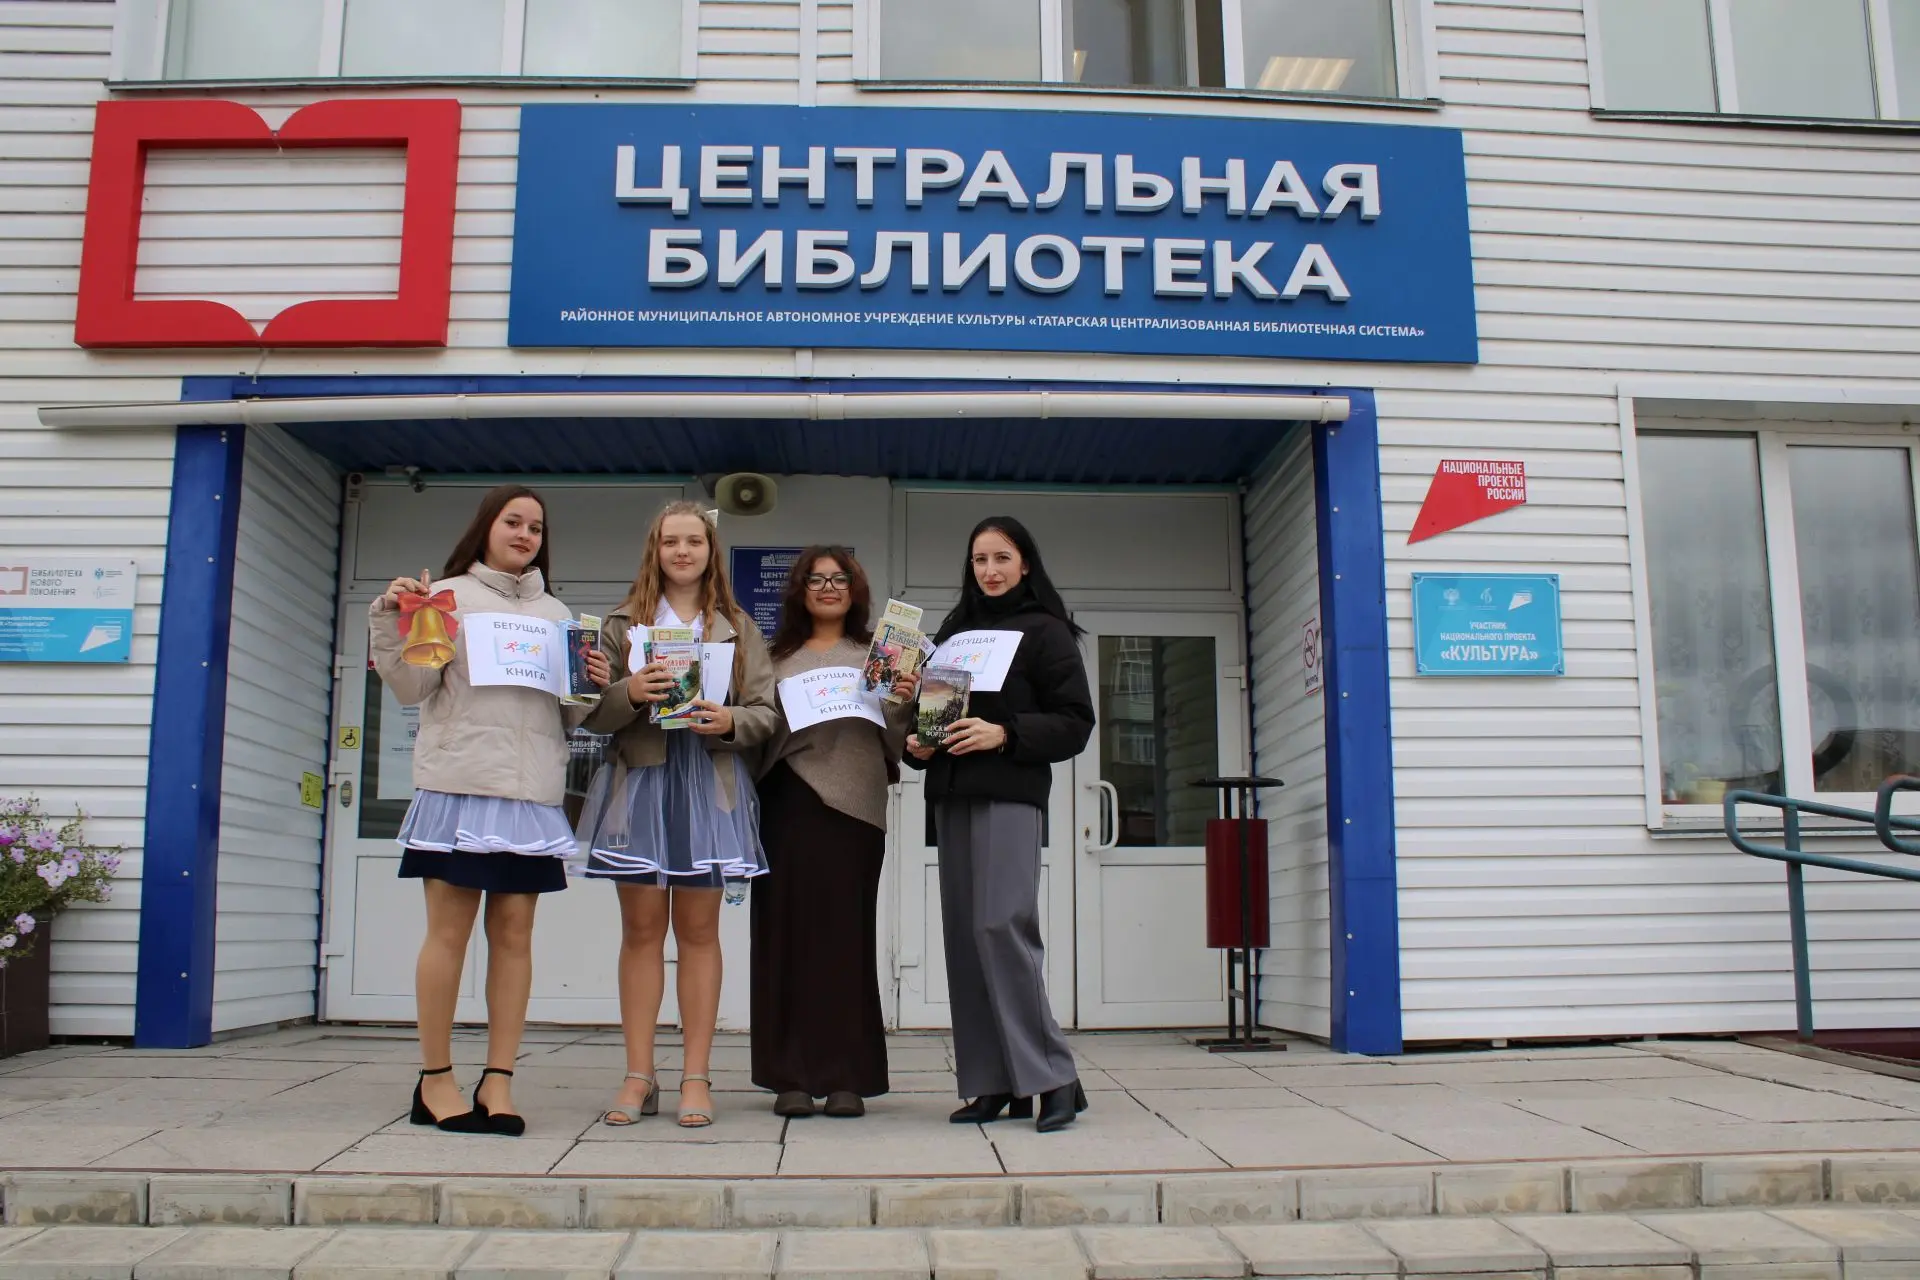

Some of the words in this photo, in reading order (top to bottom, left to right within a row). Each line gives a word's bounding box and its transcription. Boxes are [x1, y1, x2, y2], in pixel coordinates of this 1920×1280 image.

[613, 144, 1382, 221] ЦЕНТРАЛЬНАЯ
[646, 227, 1352, 303] БИБЛИОТЕКА
[560, 308, 635, 322] РАЙОННОЕ
[638, 310, 763, 324] МУНИЦИПАЛЬНОЕ
[766, 311, 861, 323] АВТОНОМНОЕ
[863, 312, 954, 326] УЧРЕЖДЕНИЕ
[957, 313, 1025, 326] КУЛЬТУРЫ
[1028, 315, 1107, 328] «ТАТАРСКАЯ
[1110, 317, 1250, 333] ЦЕНТРАЛИЗОВАННАЯ
[1253, 321, 1356, 335] БИБЛИОТЕЧНАЯ
[1358, 325, 1425, 337] СИСТЕМА»
[1442, 461, 1523, 475] НАЦИОНАЛЬНЫЕ
[1478, 475, 1524, 488] ПРОЕКТЫ
[1487, 488, 1525, 500] РОССИИ
[493, 621, 547, 636] БЕГУЩАЯ
[1469, 622, 1507, 630] УЧАСТНИК
[951, 636, 996, 648] БЕГУЩАЯ
[1440, 632, 1502, 642] НАЦИОНАЛЬНОГО
[1504, 632, 1536, 641] ПРОЕКТА
[1441, 645, 1539, 661] «КУЛЬТУРА»
[505, 667, 547, 681] КНИГА
[802, 671, 856, 685] БЕГУЩАЯ
[819, 702, 863, 715] КНИГА
[566, 740, 602, 748] СИБИРЬ
